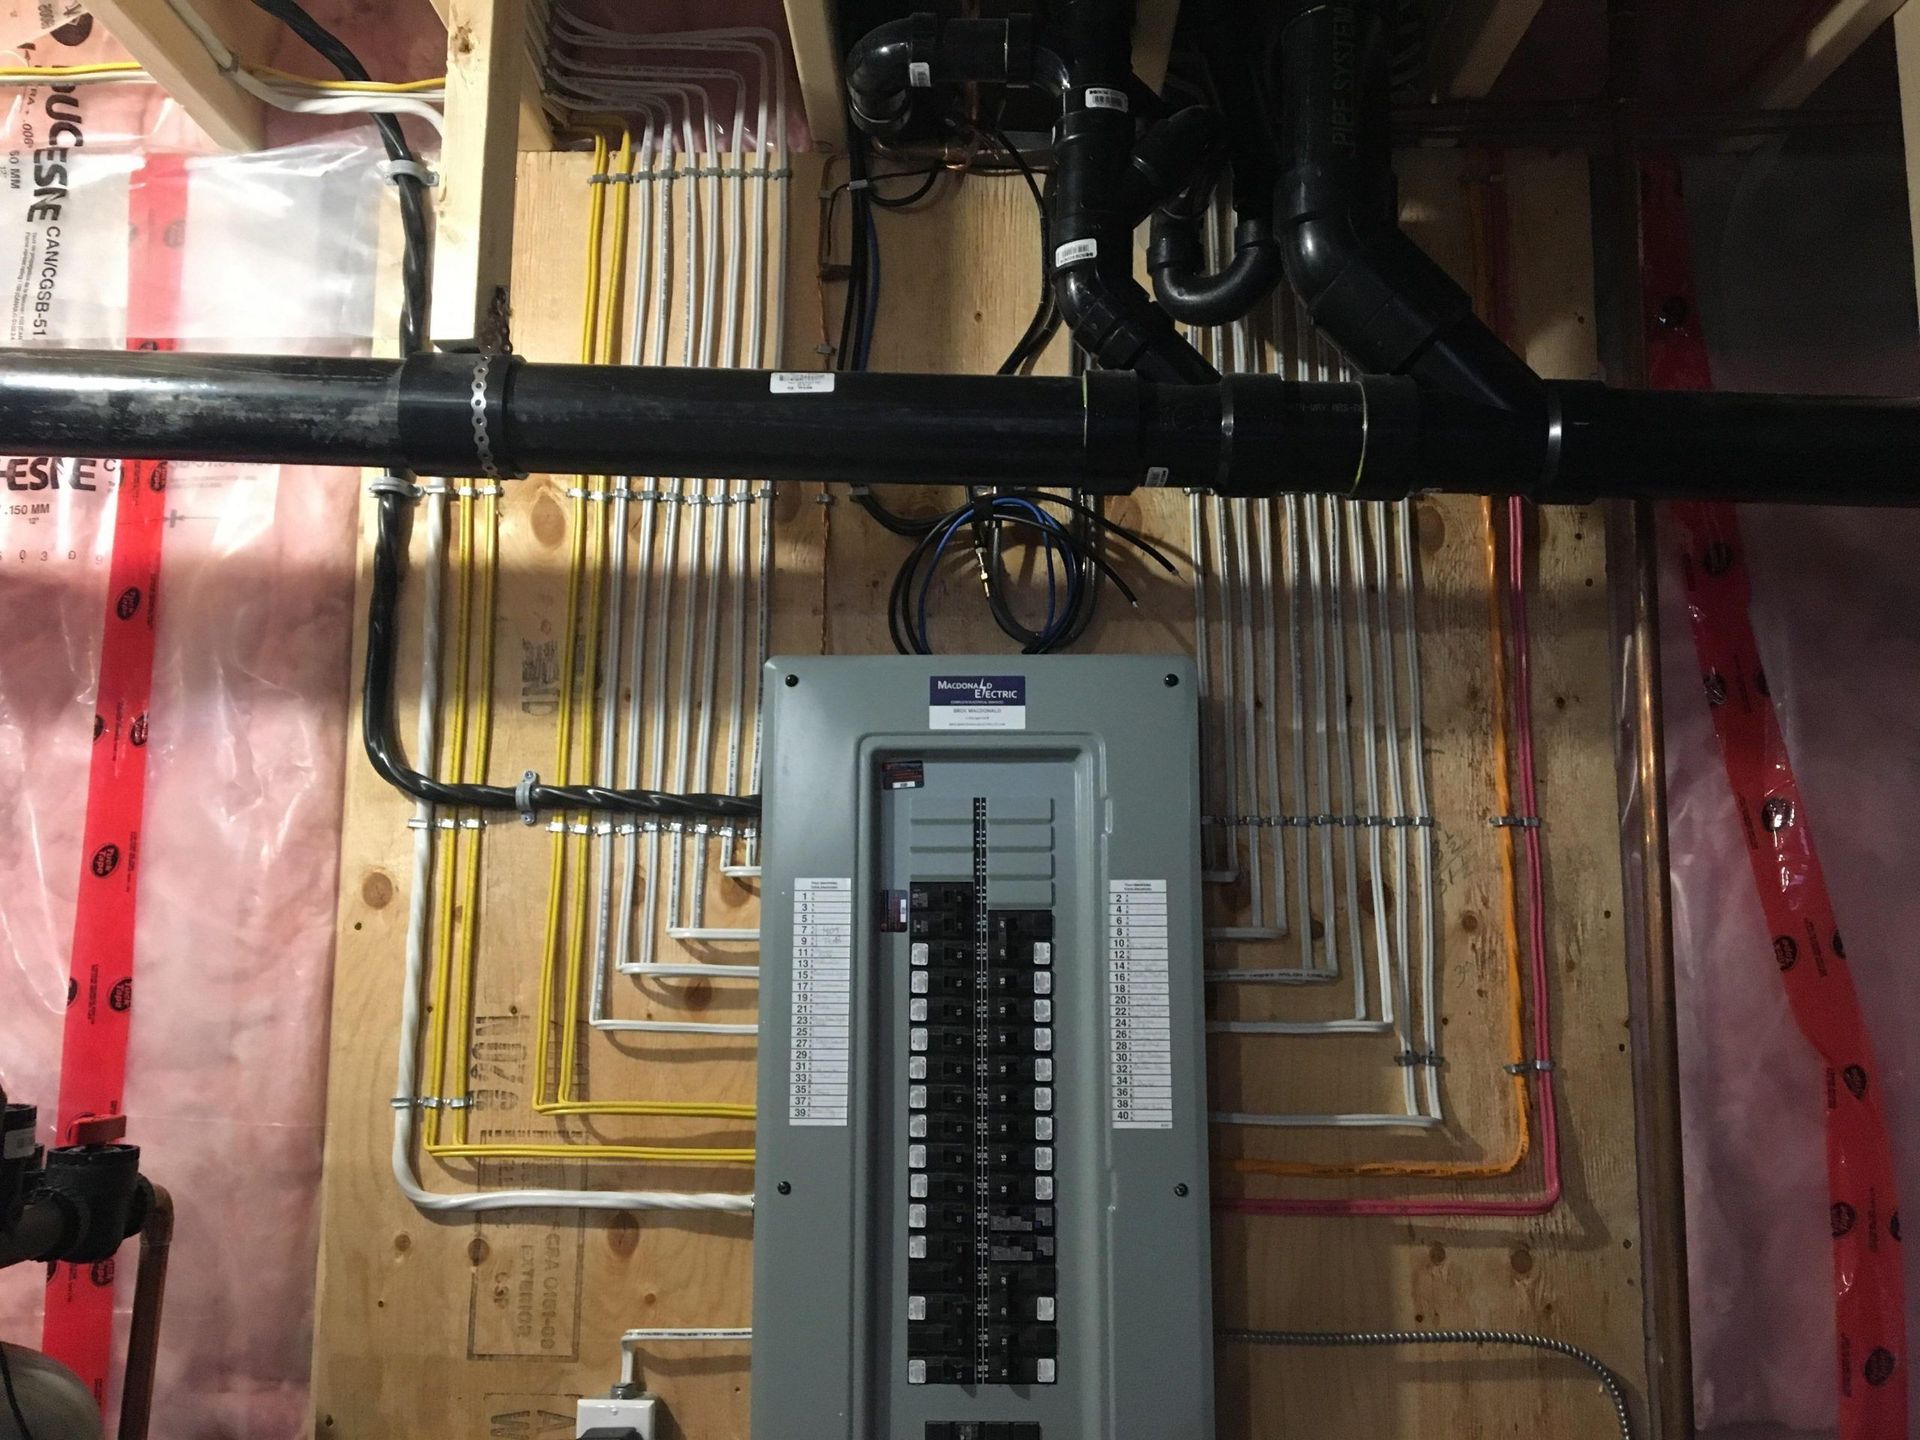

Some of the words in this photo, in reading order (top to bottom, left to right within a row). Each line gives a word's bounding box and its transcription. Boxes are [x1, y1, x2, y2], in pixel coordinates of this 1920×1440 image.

[31, 503, 50, 514] MM
[95, 851, 106, 875] Tape
[104, 848, 114, 871] Tuck
[801, 892, 807, 900] 1
[1117, 917, 1123, 925] 6
[801, 926, 806, 934] 7
[801, 937, 806, 945] 9
[1115, 951, 1126, 959] 12
[798, 960, 808, 968] 13
[797, 971, 808, 979] 15
[1116, 985, 1126, 993] 18
[114, 985, 125, 1009] Tape
[797, 994, 808, 1002] 19
[797, 1005, 808, 1013] 21
[1116, 1008, 1127, 1016] 22
[797, 1017, 808, 1025] 23
[1116, 1019, 1127, 1027] 24
[797, 1028, 807, 1036] 25
[1116, 1031, 1127, 1039] 26
[796, 1040, 807, 1048] 27
[1117, 1042, 1127, 1050] 28
[796, 1051, 807, 1059] 29
[1117, 1054, 1128, 1062] 30
[796, 1063, 807, 1071] 31
[1117, 1065, 1128, 1073] 32
[796, 1074, 807, 1082] 33
[1117, 1077, 1128, 1085] 34
[796, 1086, 807, 1094] 35
[1117, 1088, 1128, 1096] 36
[796, 1097, 806, 1105] 37
[1118, 1100, 1128, 1108] 38
[795, 1109, 806, 1117] 39
[1118, 1111, 1129, 1120] 40
